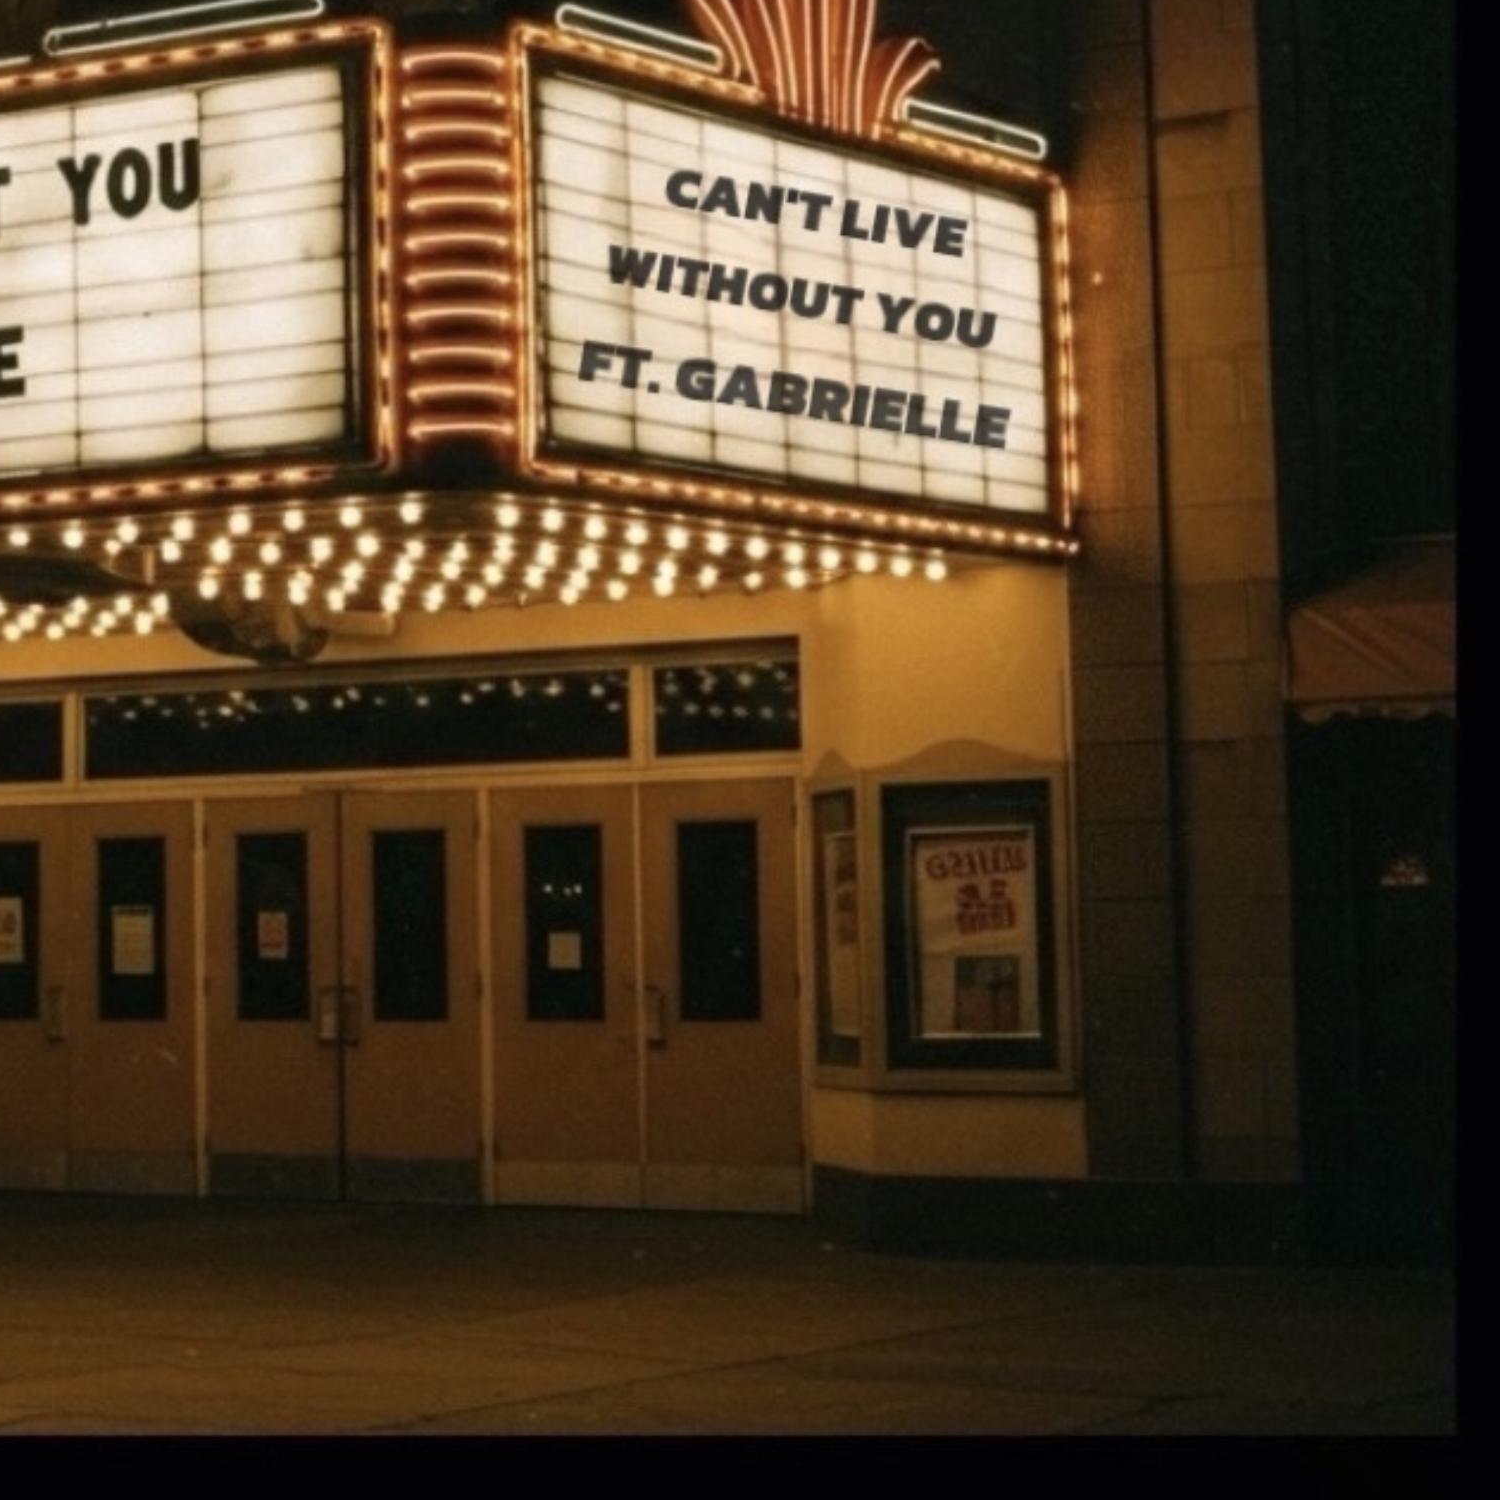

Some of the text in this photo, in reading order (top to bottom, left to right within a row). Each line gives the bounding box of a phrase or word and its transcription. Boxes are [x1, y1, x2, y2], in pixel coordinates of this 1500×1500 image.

[57, 137, 202, 226] YOU
[665, 170, 968, 258] CAN'T LIVE
[607, 244, 997, 349] WITHOUT YOU
[577, 339, 1011, 450] FT. GABRIELLE
